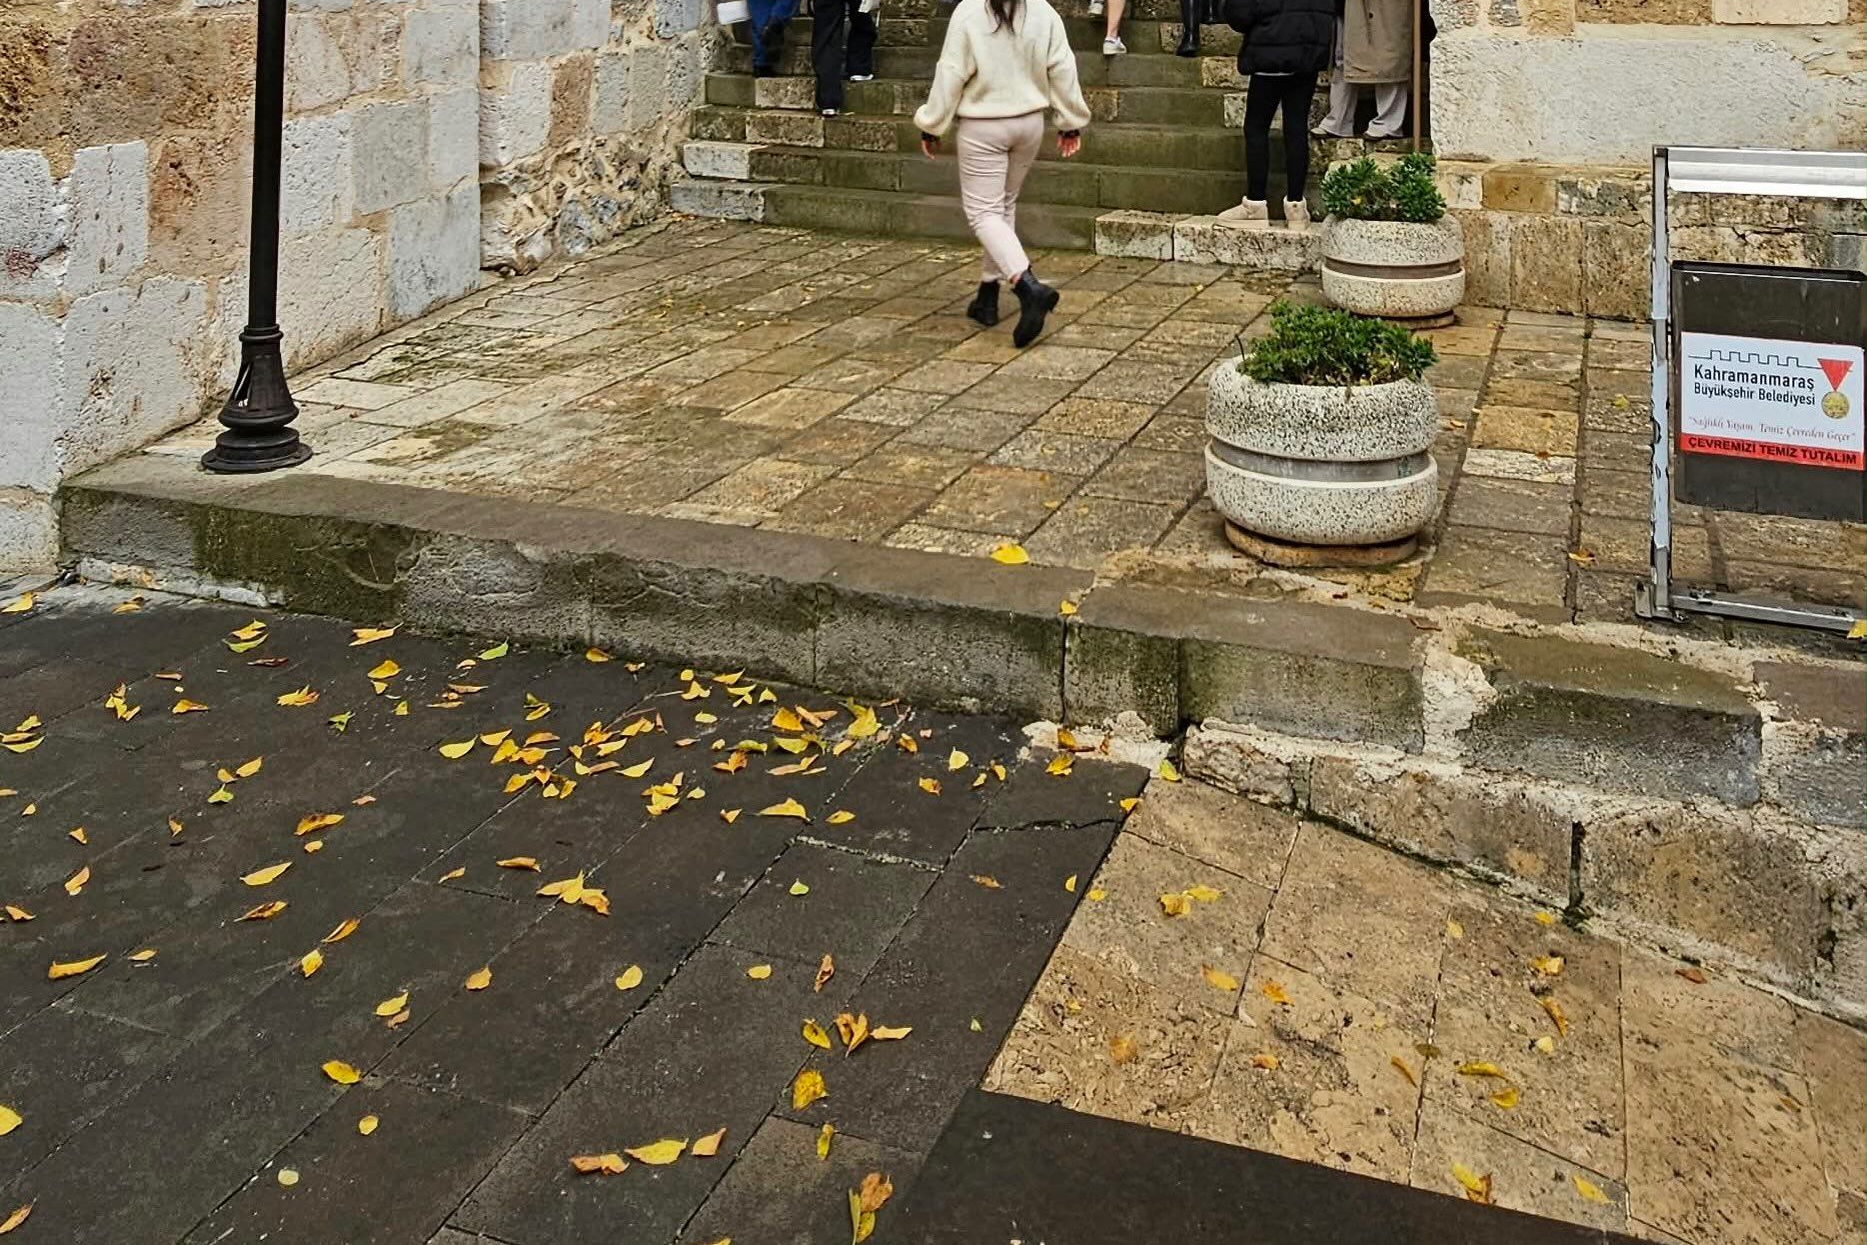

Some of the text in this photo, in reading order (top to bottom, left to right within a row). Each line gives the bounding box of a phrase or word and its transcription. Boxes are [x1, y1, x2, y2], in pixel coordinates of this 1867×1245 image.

[1694, 364, 1815, 392] Kahramanmaraş
[1694, 383, 1816, 407] Büyükşehir Belediyesi
[1800, 449, 1857, 465] TUTALIM
